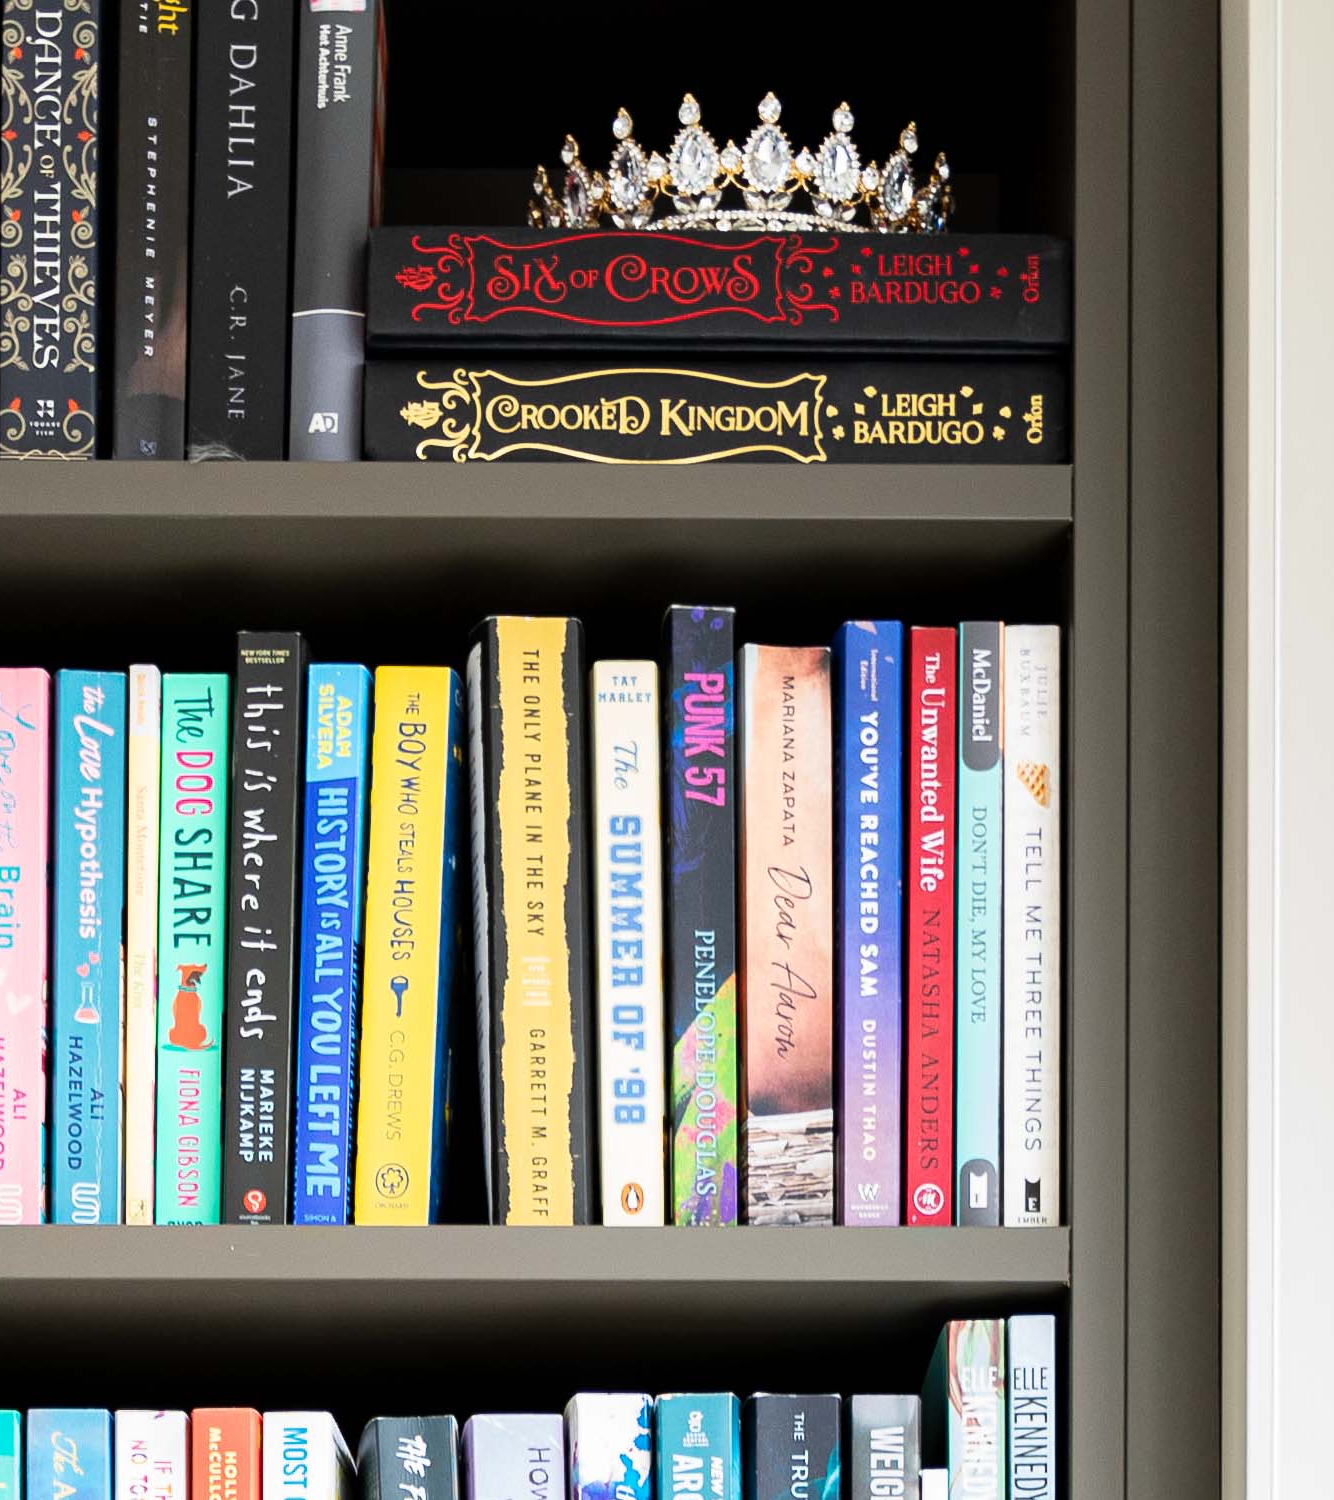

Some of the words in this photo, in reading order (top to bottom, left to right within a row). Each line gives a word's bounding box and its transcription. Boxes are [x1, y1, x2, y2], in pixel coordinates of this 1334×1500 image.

[334, 25, 351, 61] Anne
[333, 65, 350, 102] Frank
[227, 45, 256, 199] DAHLIA
[144, 117, 158, 258] STEPHENIE
[486, 254, 566, 298] SIX
[605, 254, 758, 302] CROWS
[851, 278, 979, 304] BARDUGO
[878, 254, 951, 277] LEIGH
[144, 278, 155, 358] MEYER
[486, 395, 651, 436] CROOKED
[661, 399, 811, 438] KINGDOM
[854, 417, 984, 446] BARDUGO
[880, 393, 956, 418] LEIGH
[923, 652, 939, 682] The
[175, 688, 213, 744] The
[683, 672, 725, 756] PUNK
[176, 752, 214, 816] DOG
[919, 688, 945, 822] Unwanted
[685, 768, 725, 806] 57
[172, 828, 213, 948] SHARE
[859, 815, 879, 934] REACHED
[921, 832, 945, 892] Wife
[1025, 828, 1042, 890] TELL
[1025, 906, 1041, 942] ME
[695, 930, 716, 1062] PENELOPE
[859, 945, 878, 998] SAM
[1025, 952, 1042, 1039] THREE
[1025, 1051, 1042, 1151] THINGS
[696, 1072, 717, 1196] DOUGLAS
[283, 1428, 306, 1491] MOST
